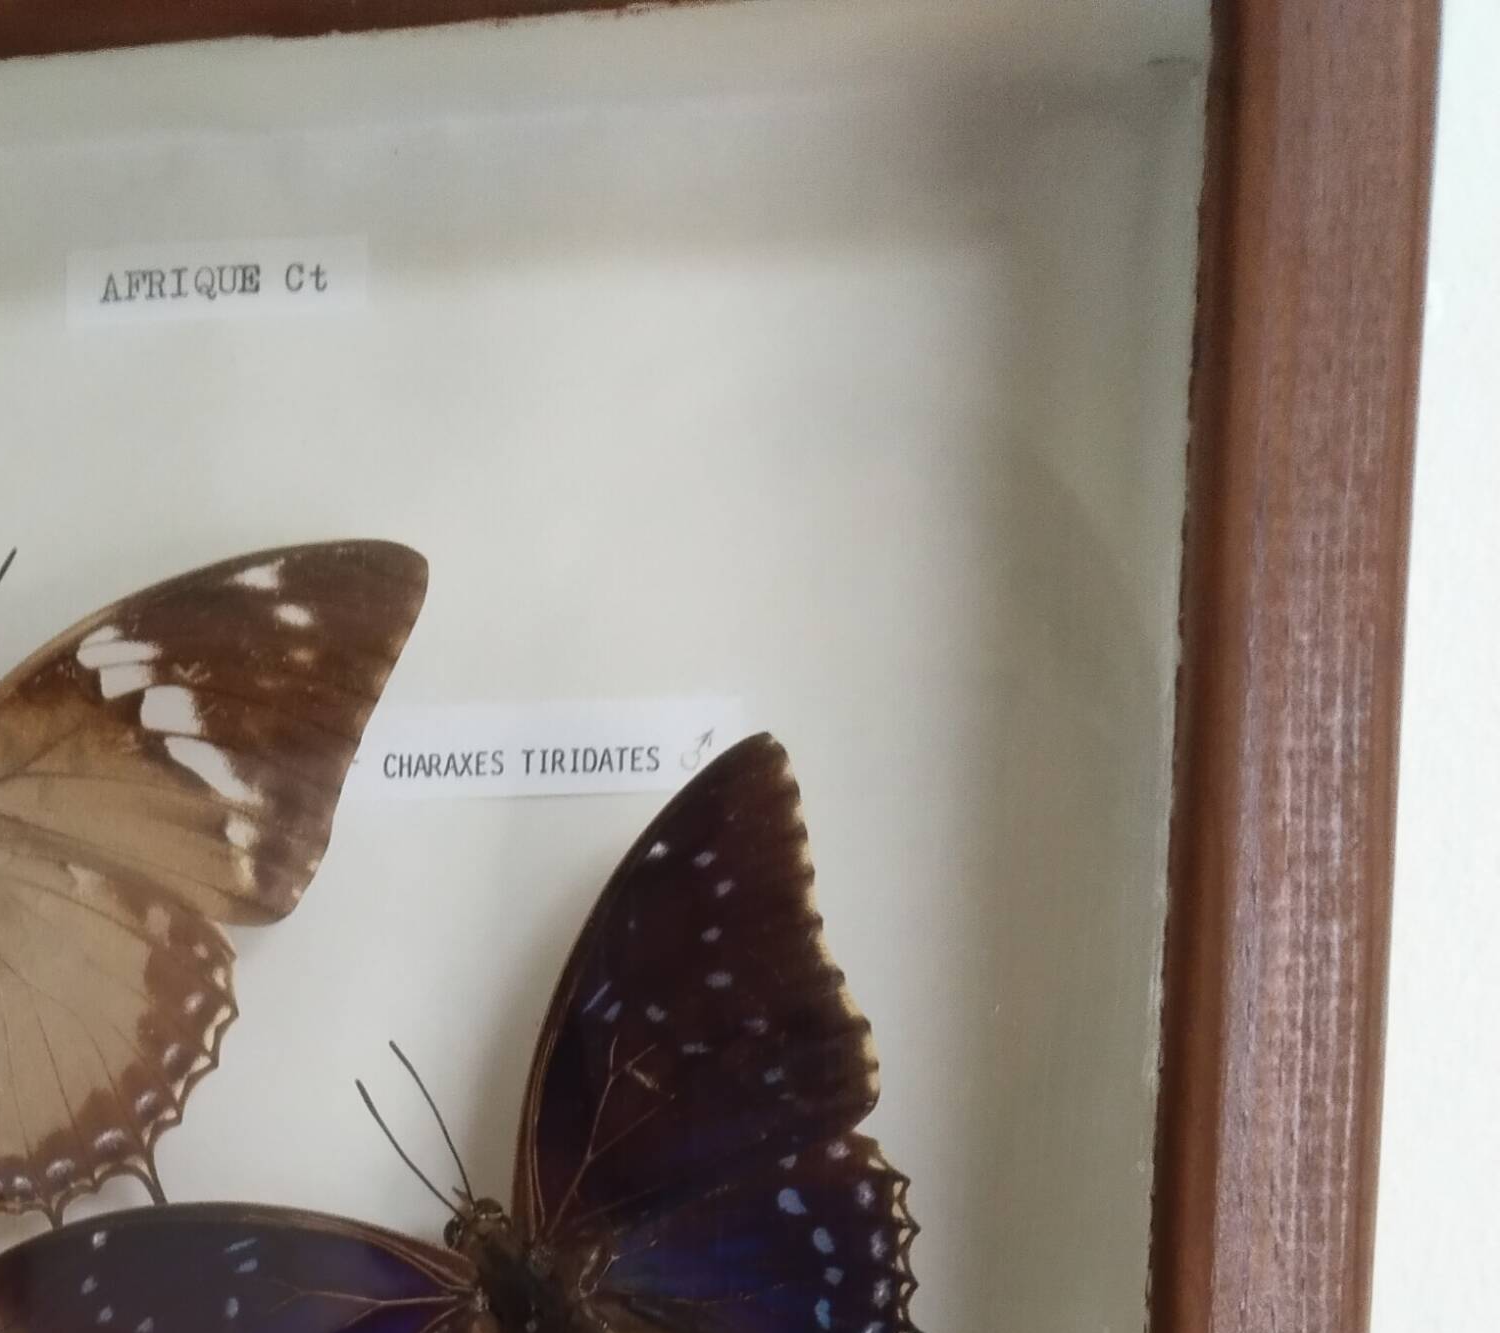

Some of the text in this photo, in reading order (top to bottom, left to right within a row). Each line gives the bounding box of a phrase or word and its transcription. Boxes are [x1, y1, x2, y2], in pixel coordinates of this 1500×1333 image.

[101, 263, 328, 302] AFRIQUE Ct
[383, 745, 660, 779] CHARAXES TIRIDATES
